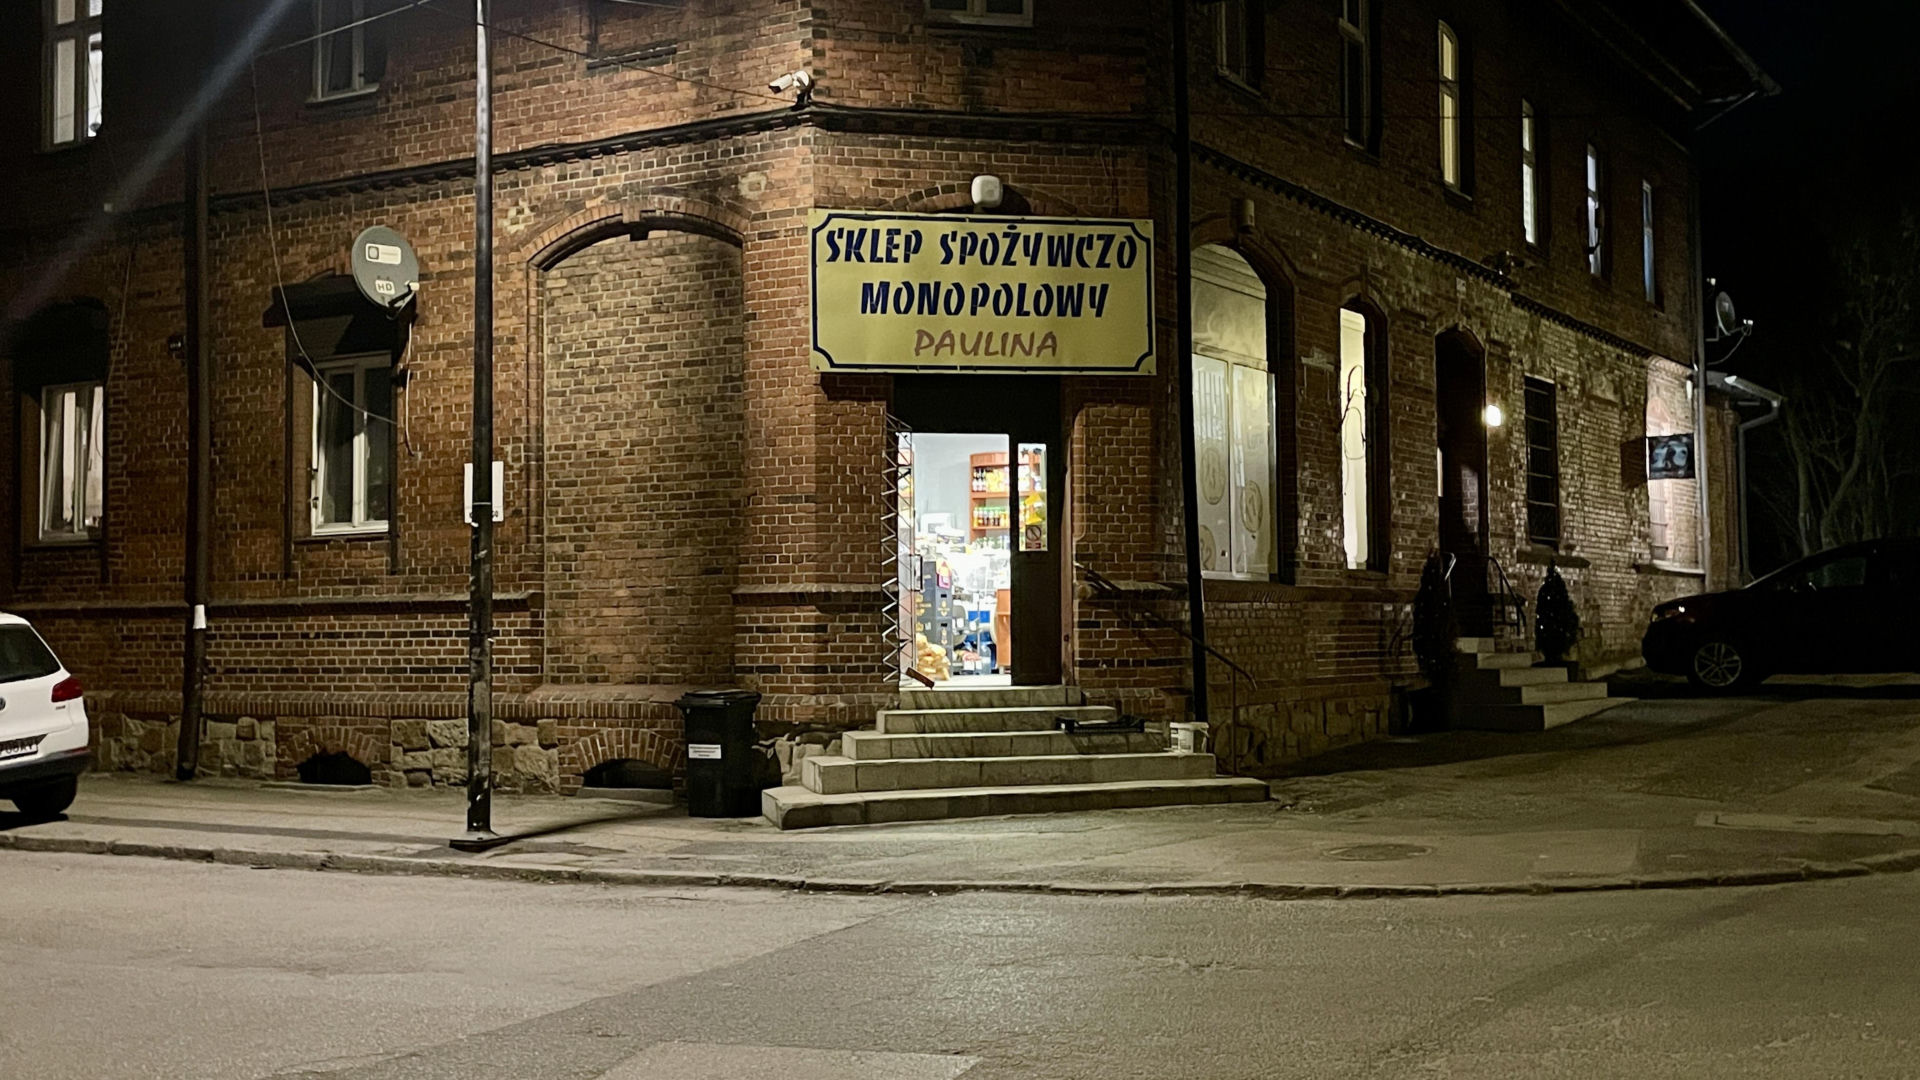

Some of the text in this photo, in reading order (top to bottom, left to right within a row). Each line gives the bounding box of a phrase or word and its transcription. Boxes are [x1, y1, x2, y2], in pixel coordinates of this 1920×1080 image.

[826, 224, 1137, 269] SKLEP SPOŻYWCZO
[377, 283, 393, 291] HD
[861, 281, 1109, 317] MONOPOLOWY
[914, 329, 1058, 357] PAULINA
